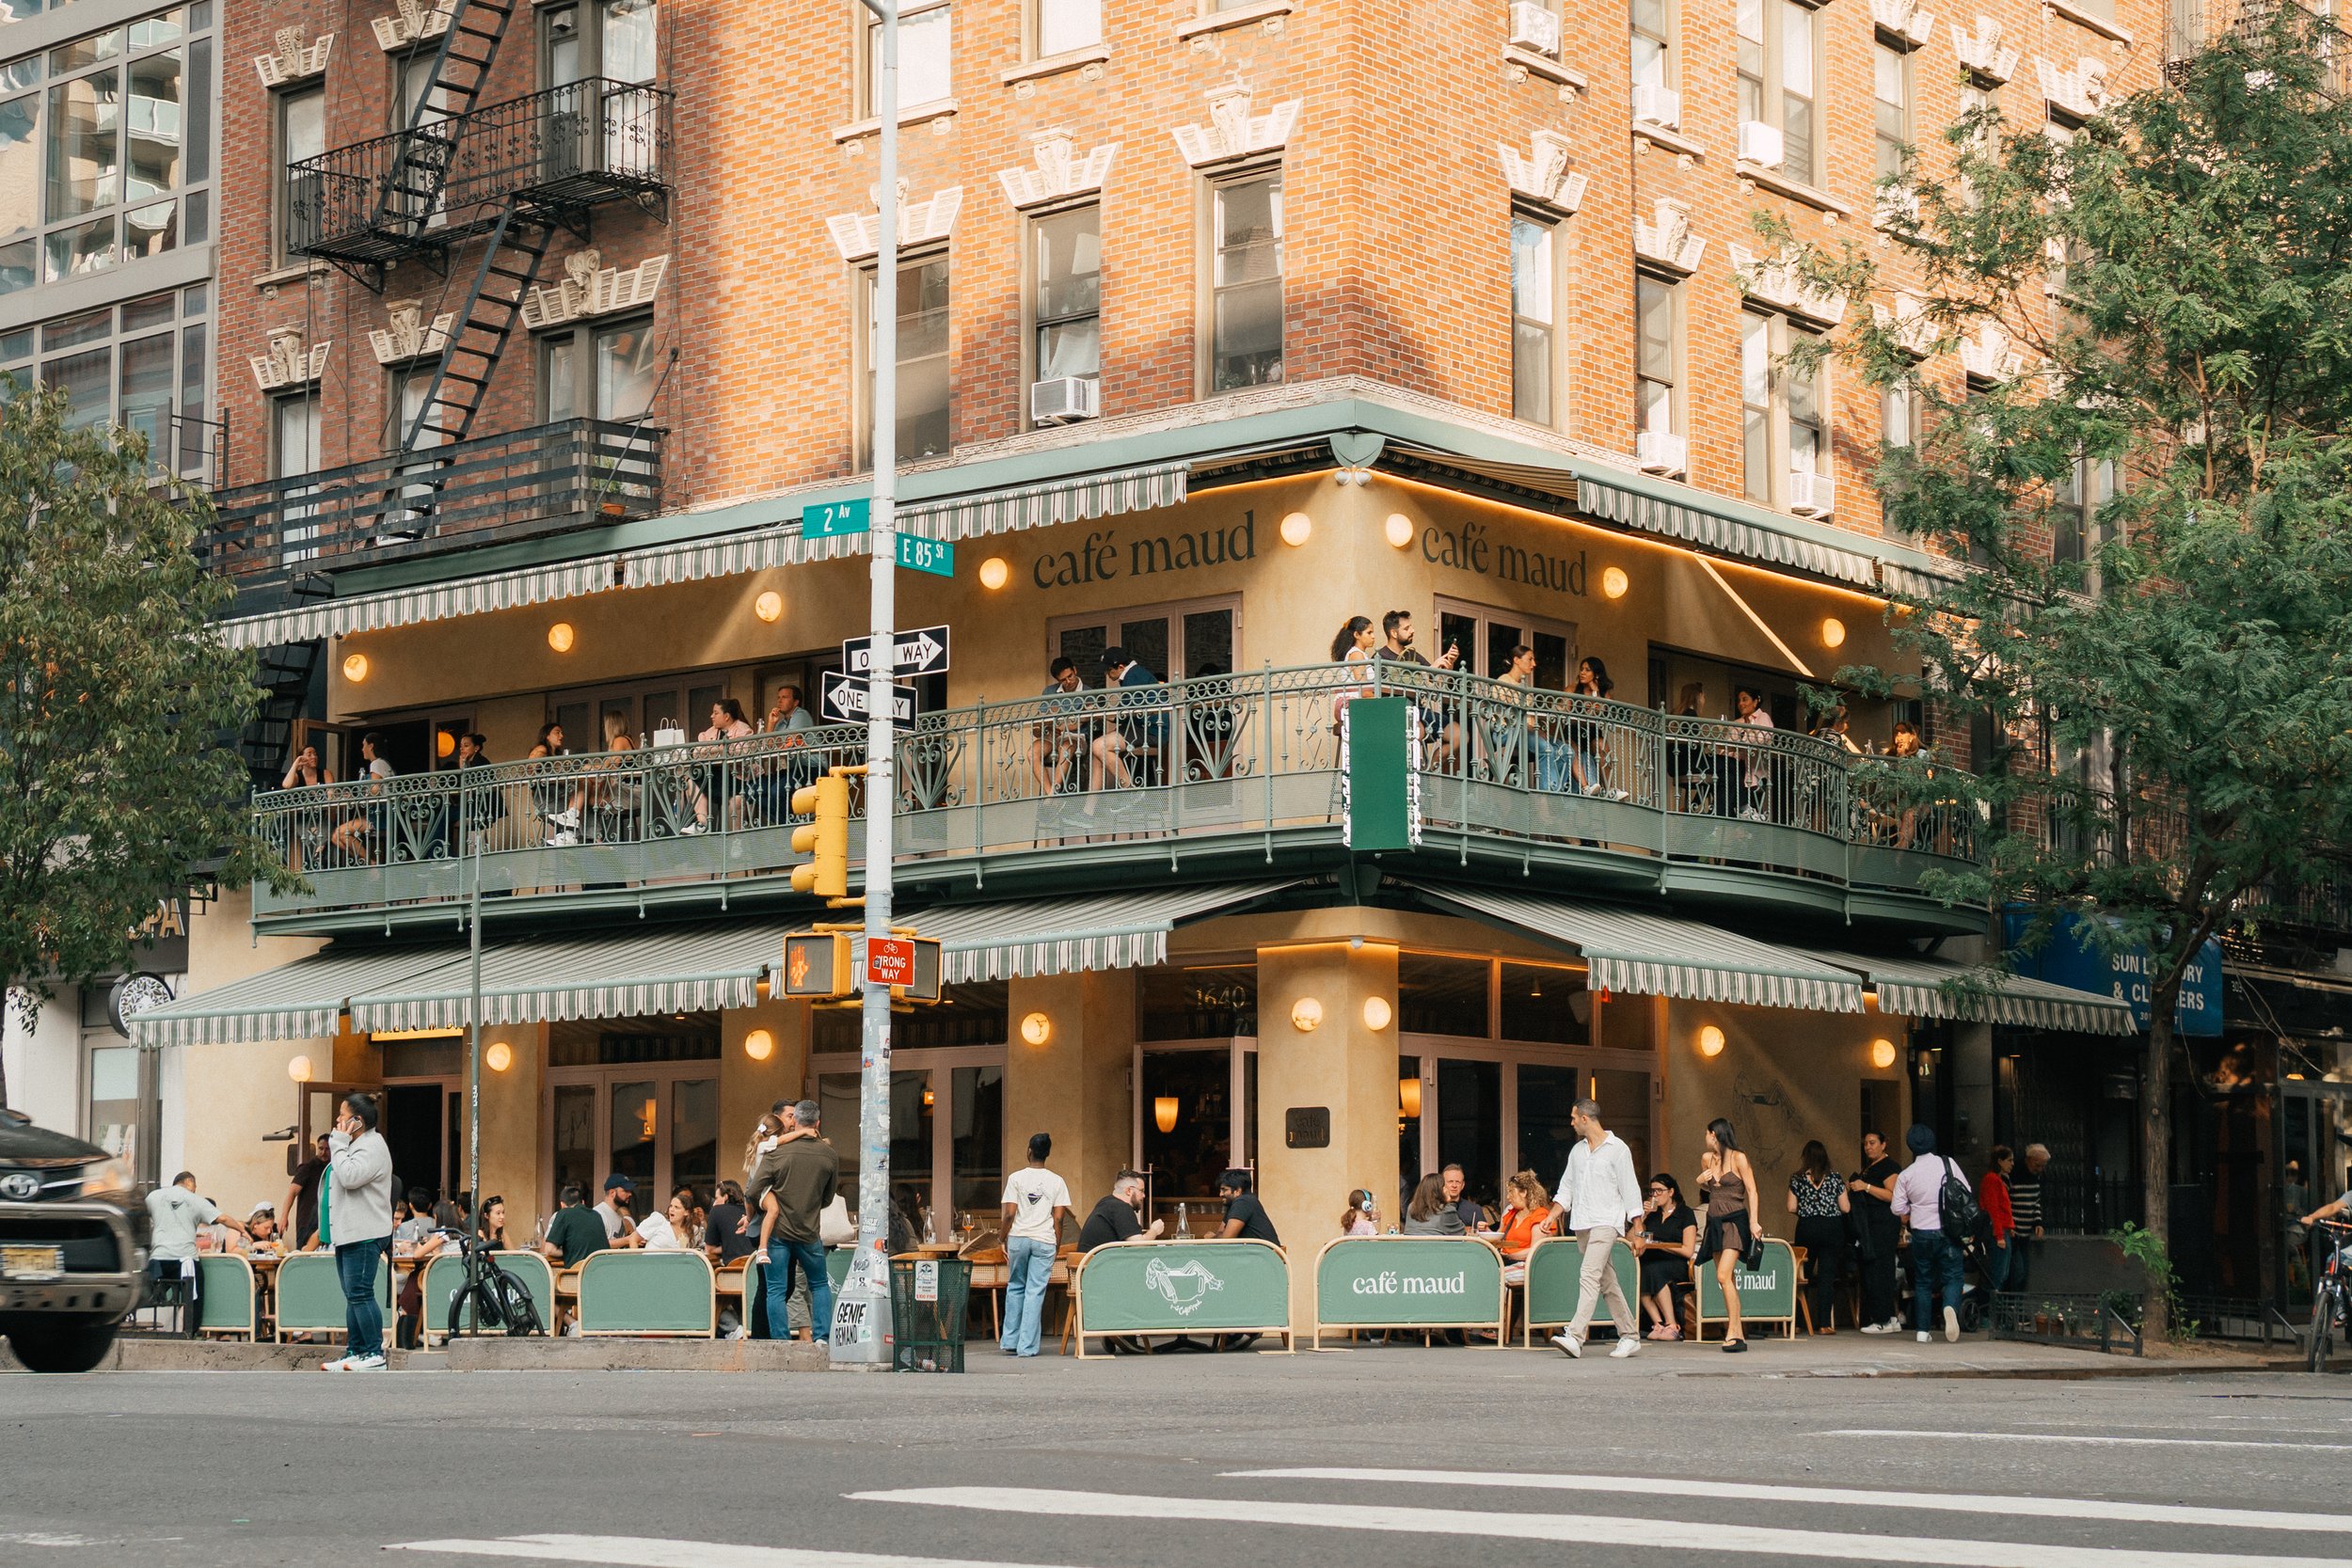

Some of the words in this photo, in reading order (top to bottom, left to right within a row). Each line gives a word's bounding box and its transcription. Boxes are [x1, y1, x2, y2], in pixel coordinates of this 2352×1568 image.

[823, 507, 834, 532] 2
[838, 504, 850, 518] Av
[903, 539, 911, 562] E
[915, 541, 932, 567] 85
[935, 544, 944, 560] St
[1033, 530, 1118, 590] café
[1129, 509, 1257, 577] maud
[1422, 521, 1489, 574] café
[1498, 550, 1588, 597] maud
[902, 642, 932, 662] WAY
[837, 689, 863, 709] ONE
[881, 968, 900, 980] WAY
[2111, 953, 2139, 974] SUN
[1196, 986, 1246, 1009] 1640
[2113, 981, 2123, 1000] &
[2132, 984, 2204, 1011] CLERS
[1353, 1271, 1398, 1294] café
[1402, 1271, 1466, 1294] maud
[1743, 1270, 1776, 1291] maud
[837, 1302, 866, 1323] GENIE
